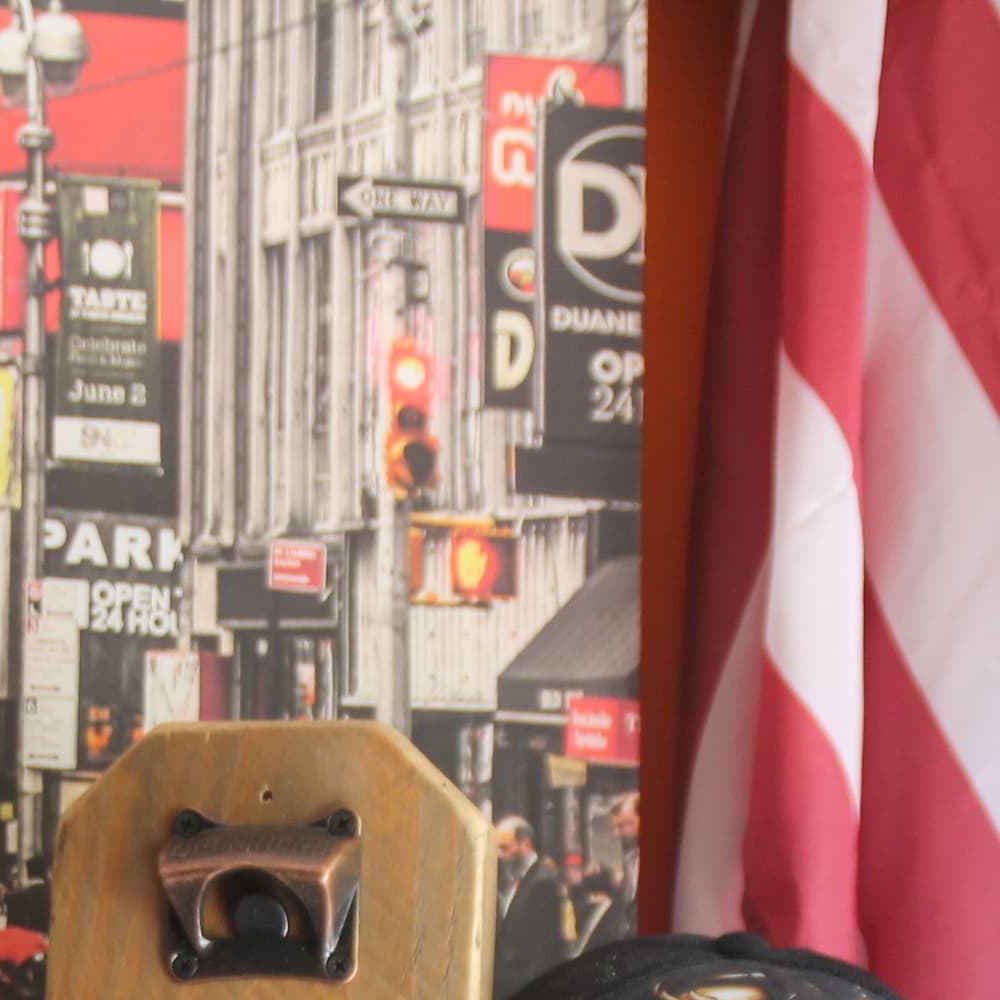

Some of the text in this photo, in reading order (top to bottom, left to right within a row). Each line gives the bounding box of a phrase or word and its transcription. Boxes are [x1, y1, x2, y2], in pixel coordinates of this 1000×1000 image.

[410, 190, 453, 211] WAY
[551, 304, 642, 337] DUANE
[68, 378, 126, 405] June
[91, 579, 171, 613] OPEN
[90, 607, 124, 634] 24
